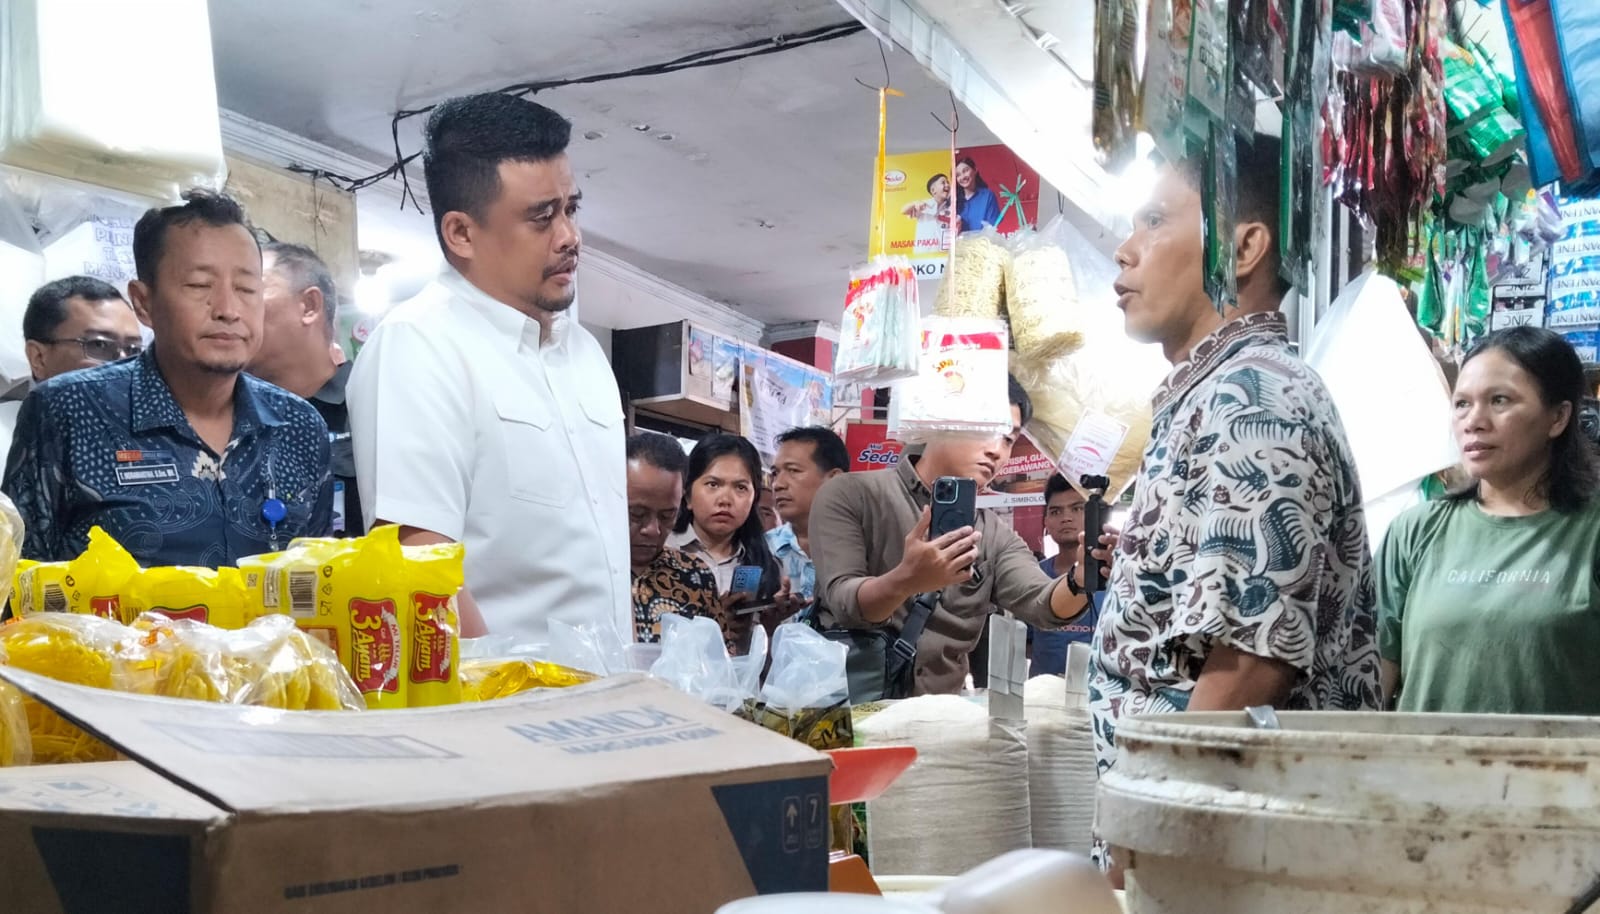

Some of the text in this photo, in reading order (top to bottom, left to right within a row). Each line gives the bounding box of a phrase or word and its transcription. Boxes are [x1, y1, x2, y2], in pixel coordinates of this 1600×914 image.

[890, 240, 915, 249] MASAK
[1503, 314, 1533, 327] ZINC
[858, 450, 899, 464] Seda
[1011, 495, 1045, 504] SIMBOLO
[1447, 568, 1550, 584] CALIFORNIA
[351, 609, 382, 679] 3 Ayam
[415, 622, 436, 669] Ayam
[505, 706, 690, 743] AMANDA
